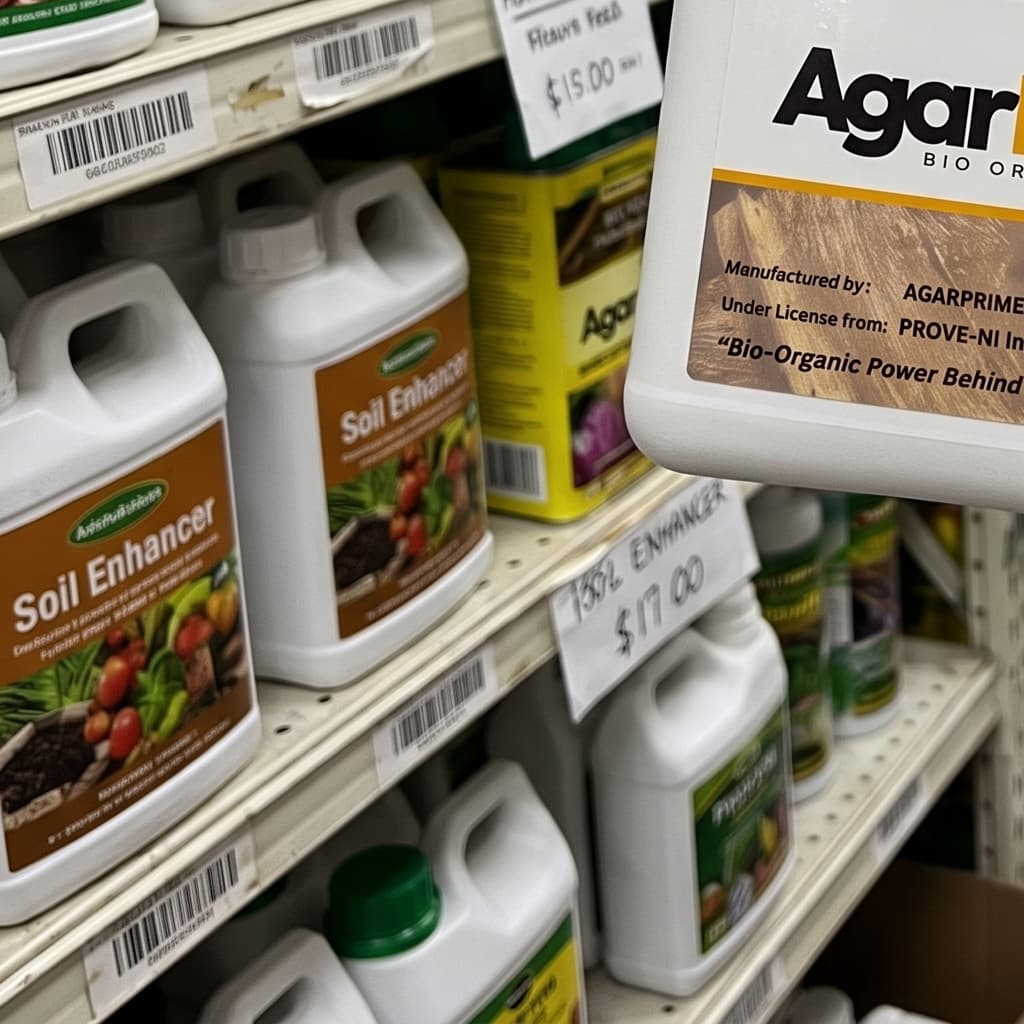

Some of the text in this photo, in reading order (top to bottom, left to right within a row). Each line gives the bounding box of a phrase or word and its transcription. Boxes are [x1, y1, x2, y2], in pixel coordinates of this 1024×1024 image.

[923, 151, 970, 172] BIO
[724, 259, 840, 292] Manufactured
[844, 275, 871, 296] by:
[902, 282, 1024, 316] AGARPRIME
[721, 295, 772, 322] Under
[775, 303, 838, 329] License
[842, 311, 888, 334] from:
[899, 317, 1001, 348] PROVE-NI
[340, 394, 386, 446] Soil
[387, 347, 469, 422] Enhancer
[716, 335, 862, 375] “Bio-Organic
[866, 355, 939, 386] Power
[942, 365, 1022, 397] Behind
[629, 478, 728, 573] ENHANCER
[13, 570, 80, 634] Soil
[87, 495, 216, 598] Enhancer
